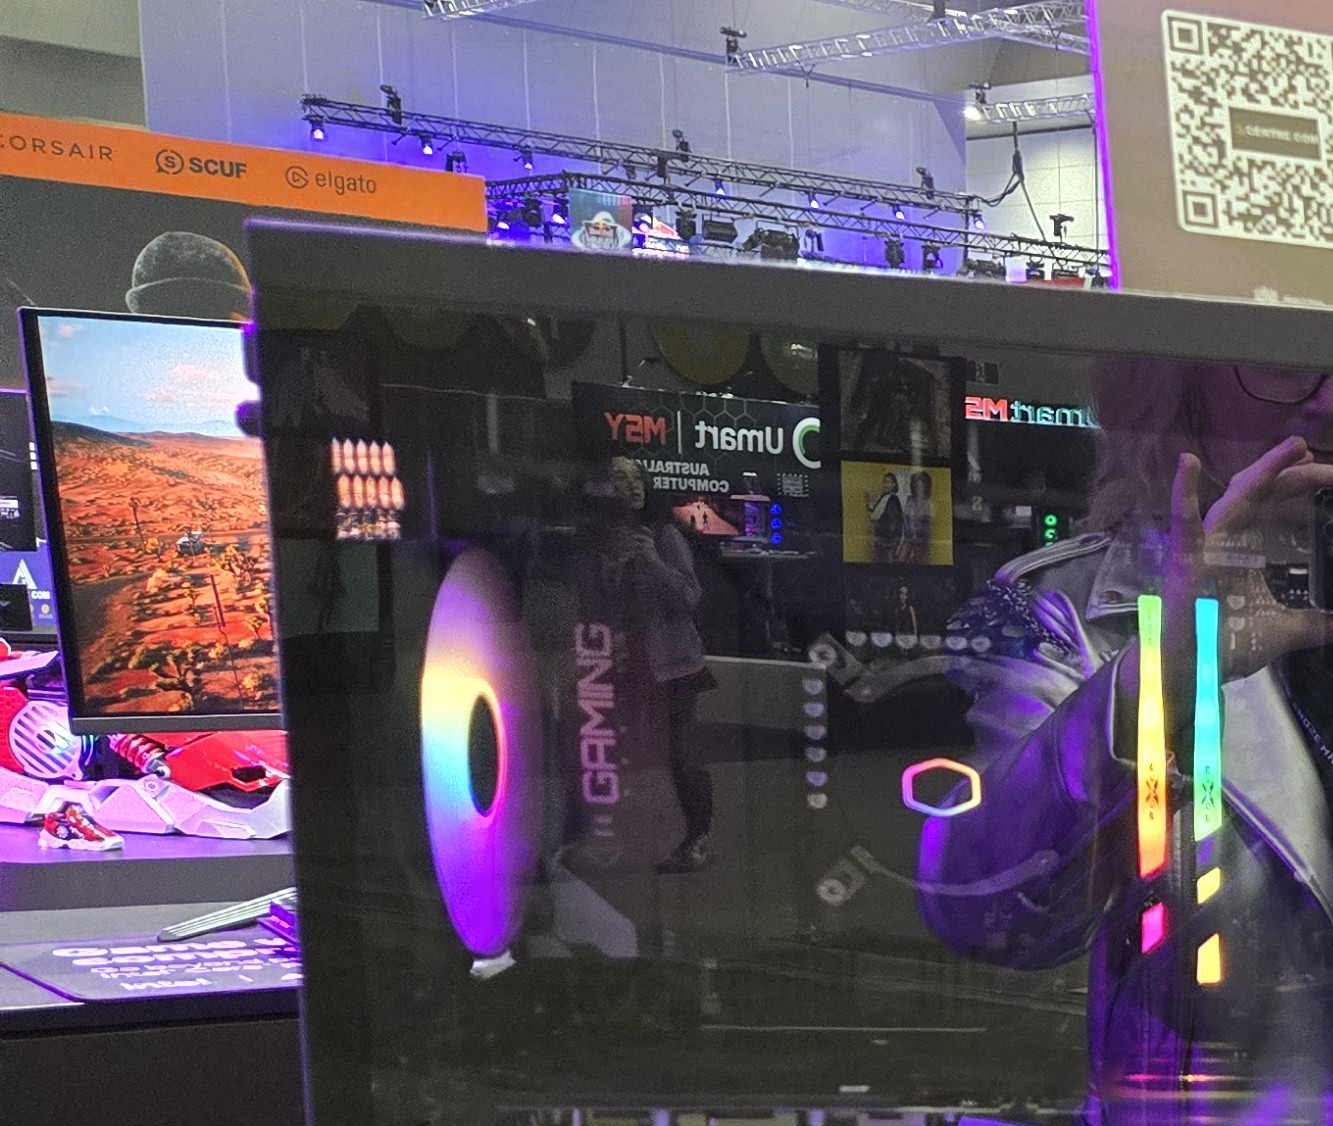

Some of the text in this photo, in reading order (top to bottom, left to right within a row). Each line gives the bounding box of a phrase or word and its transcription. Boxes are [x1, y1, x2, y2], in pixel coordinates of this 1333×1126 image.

[189, 158, 247, 179] SCUF
[315, 172, 377, 195] elgato
[575, 622, 620, 805] GAMING
